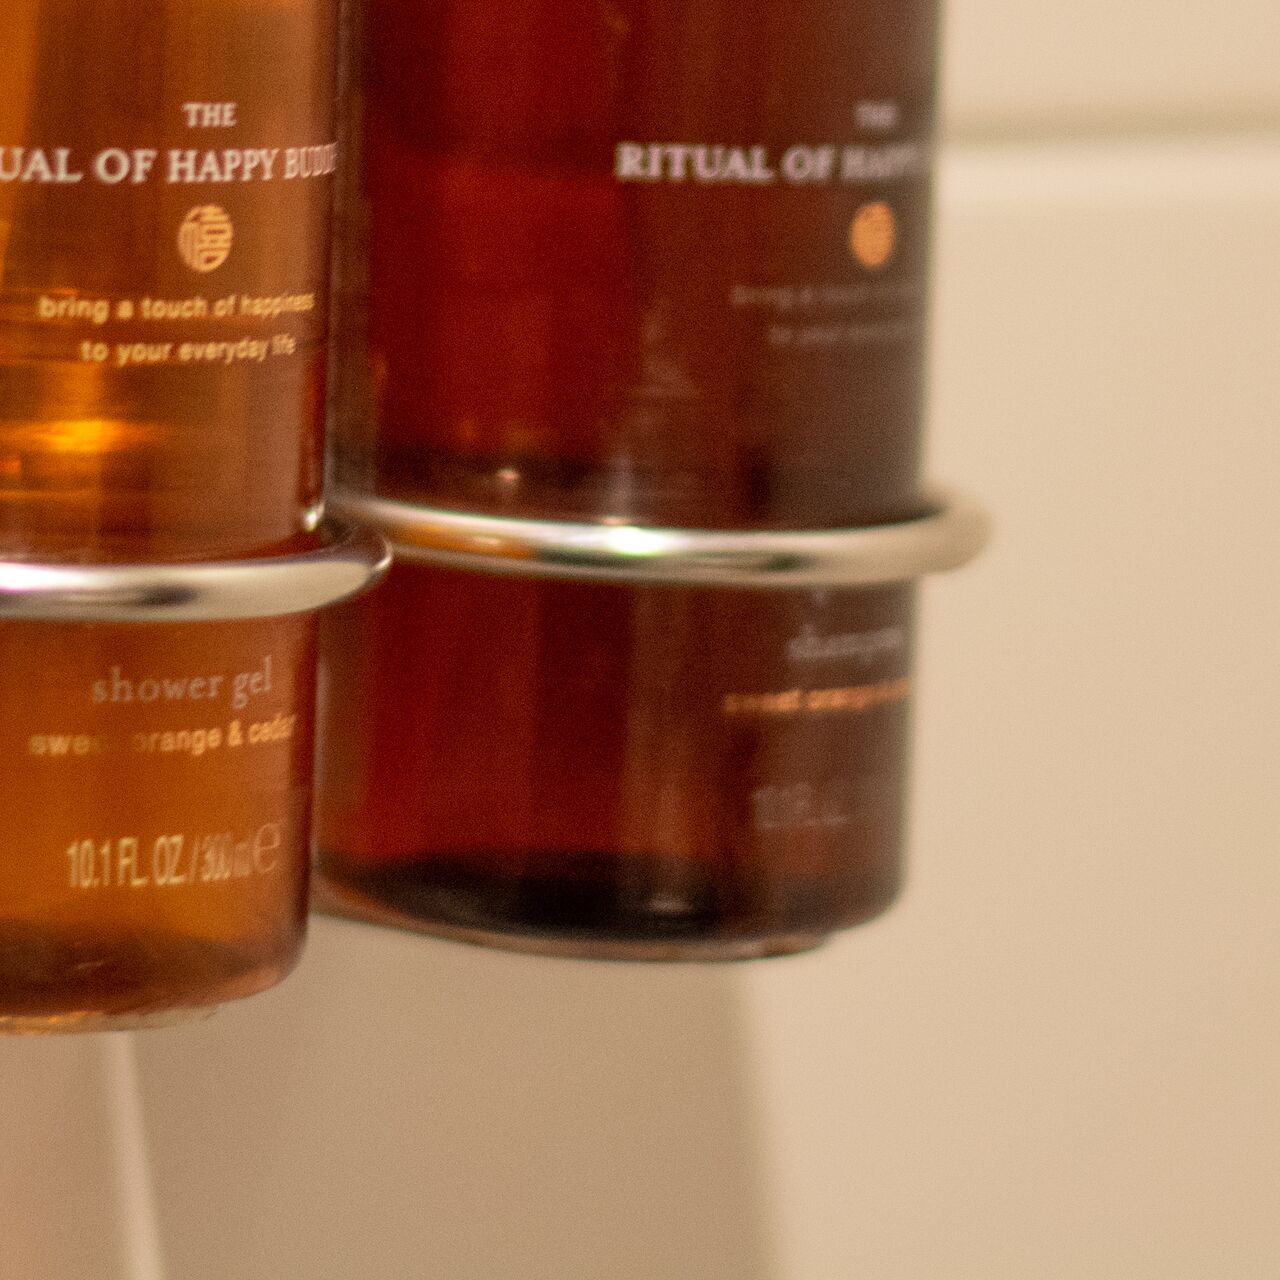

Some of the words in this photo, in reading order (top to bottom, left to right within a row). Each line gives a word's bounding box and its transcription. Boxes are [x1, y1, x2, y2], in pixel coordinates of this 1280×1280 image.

[181, 101, 238, 128] THE
[94, 147, 157, 184] OF
[165, 147, 280, 184] HAPPY
[617, 141, 776, 184] RITUAL
[781, 144, 836, 185] OF
[38, 295, 110, 324] bring
[117, 299, 134, 319] a
[140, 295, 208, 320] touch
[213, 294, 236, 318] of
[81, 340, 109, 361] to
[117, 342, 173, 367] your
[179, 336, 270, 365] everyday
[91, 666, 224, 704] shower
[232, 656, 272, 710] gel
